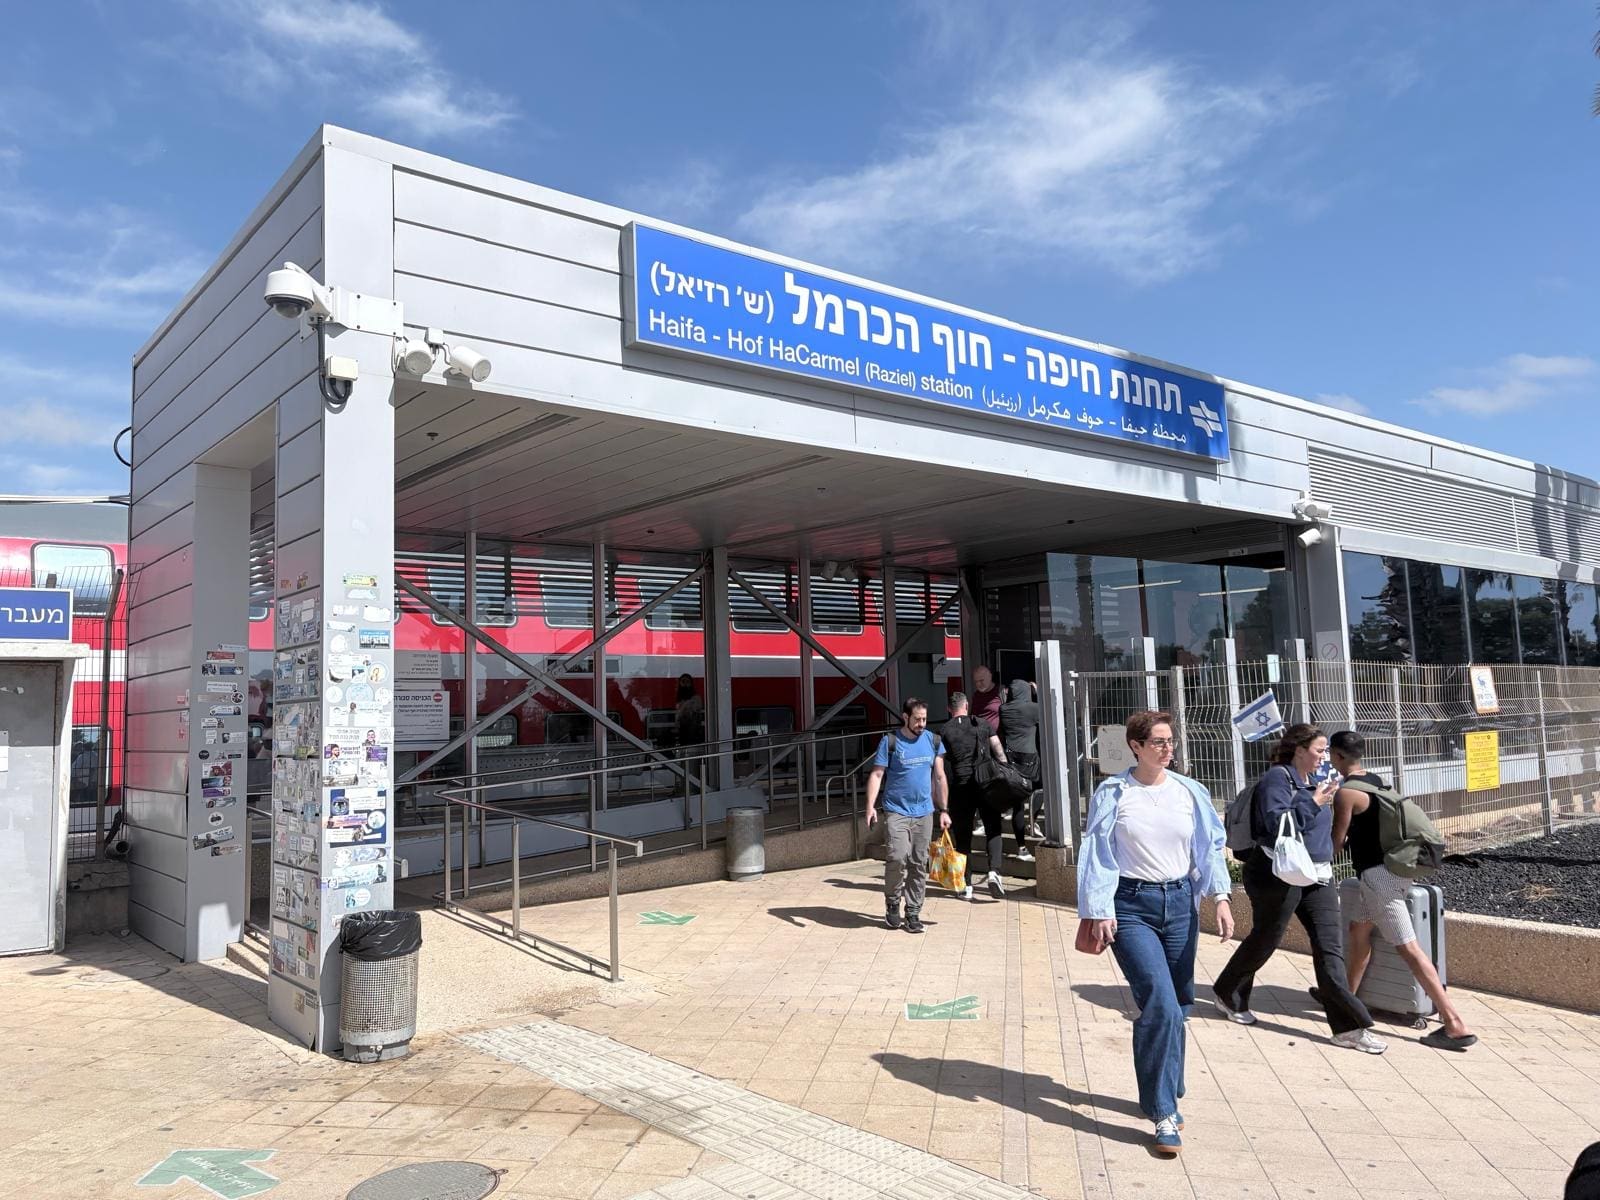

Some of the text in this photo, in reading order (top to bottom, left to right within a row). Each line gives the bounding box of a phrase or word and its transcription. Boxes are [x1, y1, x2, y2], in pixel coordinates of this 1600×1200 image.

[650, 261, 730, 307] רזיאל)
[783, 271, 920, 353] הכרמל
[649, 308, 973, 400] Haifa - Hof HaCarmel (Raziel) station
[931, 321, 993, 375] חוף
[1002, 353, 1016, 363] -
[1025, 346, 1101, 396] חיפה
[1027, 395, 1072, 421] هكرمل
[1109, 368, 1183, 415] תחנת
[1076, 407, 1104, 430] حوف
[1120, 415, 1148, 439] حيفا
[1152, 422, 1187, 444] محطة
[0, 607, 64, 623] מעבר
